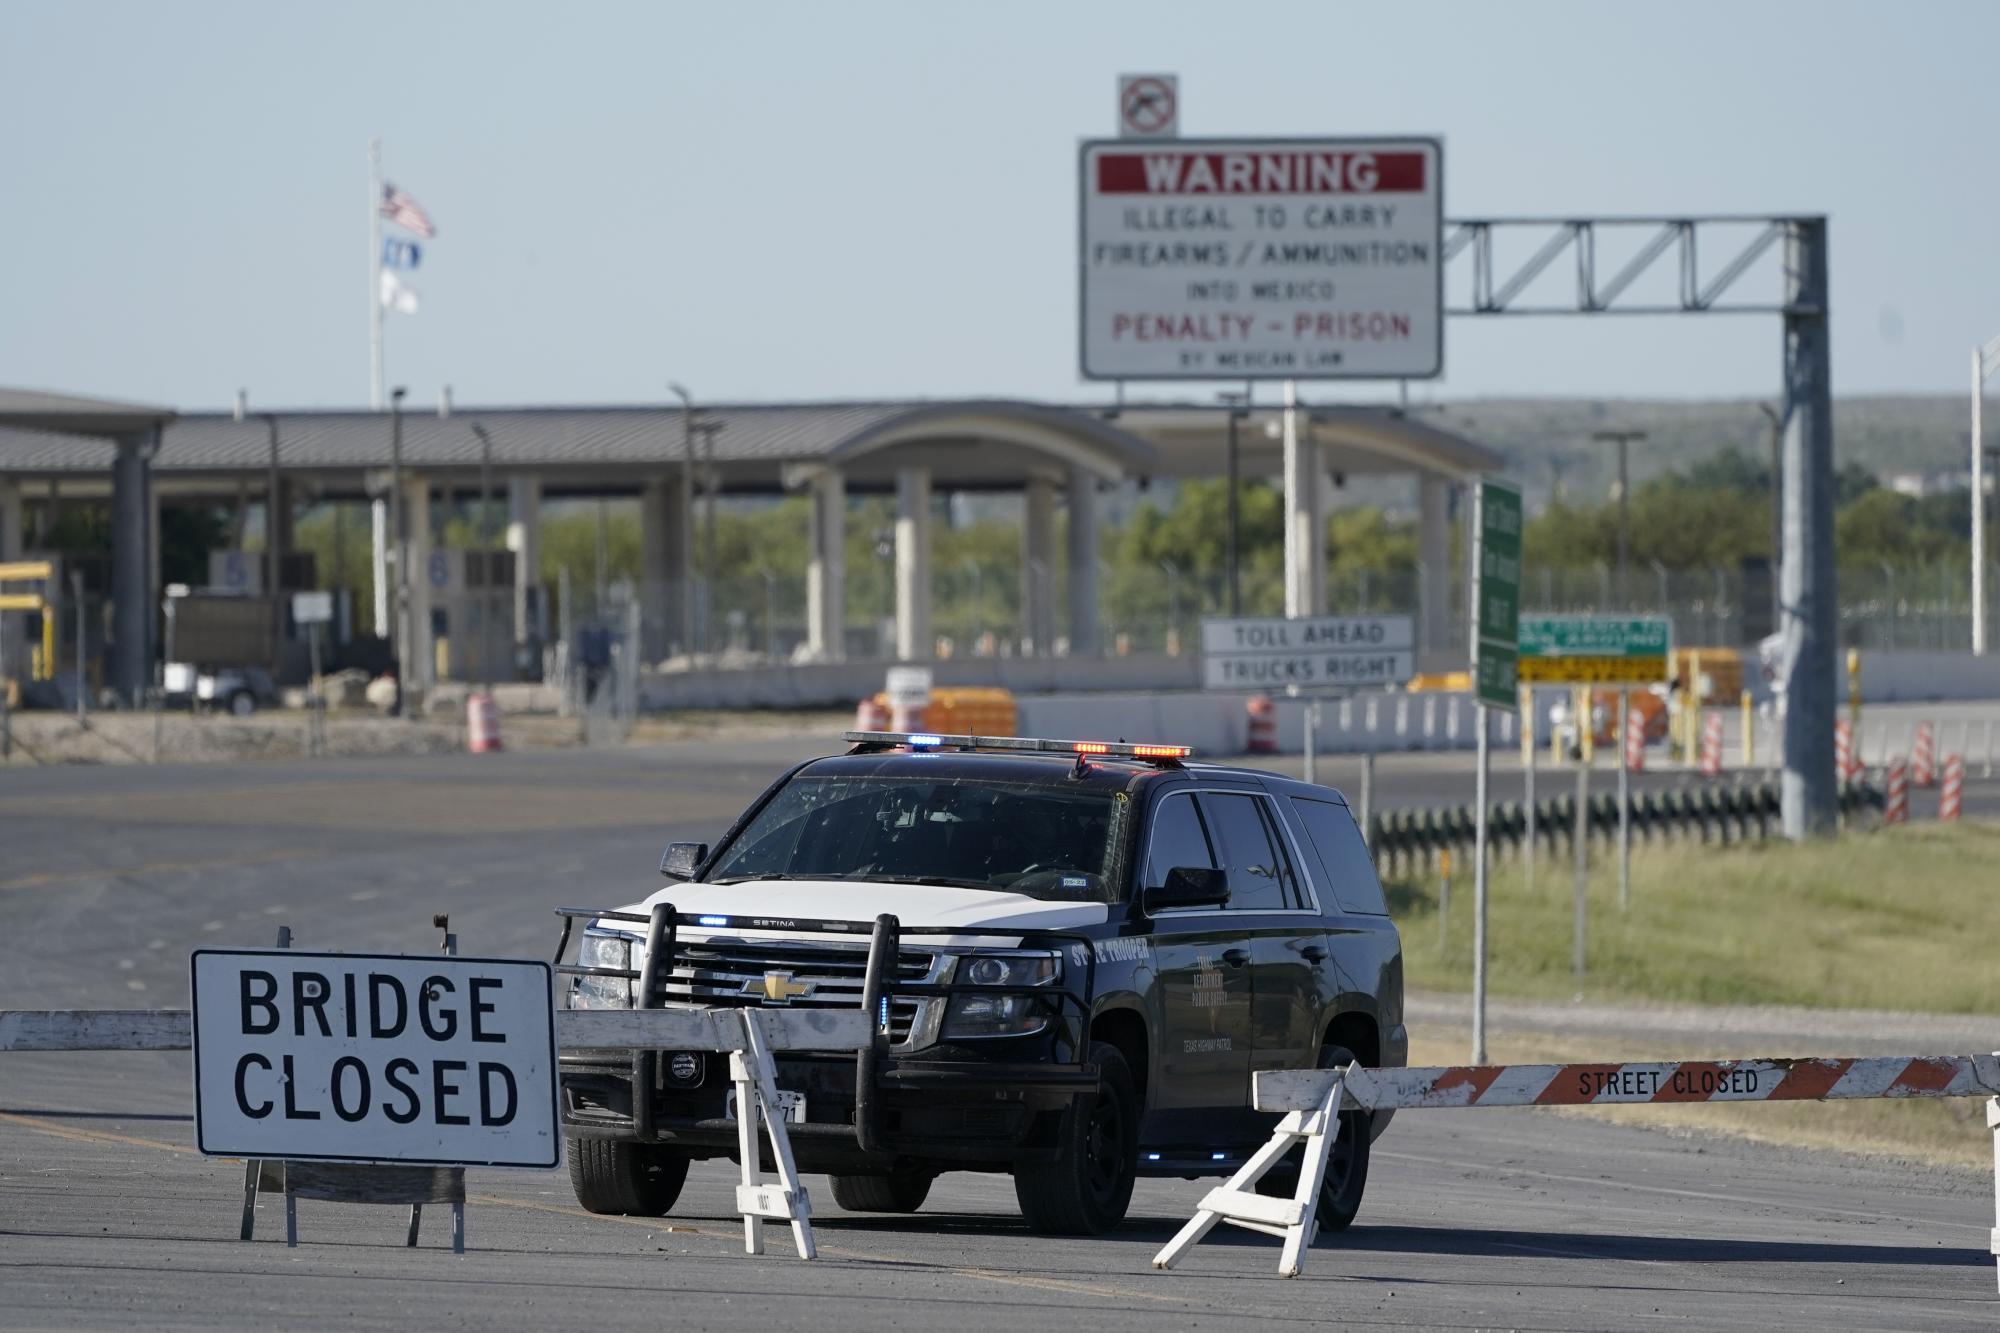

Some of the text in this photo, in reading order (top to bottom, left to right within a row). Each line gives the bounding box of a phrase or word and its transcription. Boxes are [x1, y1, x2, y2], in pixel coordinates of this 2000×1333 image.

[1143, 154, 1380, 193] WARNING
[1123, 205, 1397, 230] ILLEGAL TO CARRY
[1187, 280, 1336, 301] INTO MEXICO
[1112, 314, 1255, 341] PENALTY
[1293, 312, 1410, 339] PRISON
[1180, 350, 1344, 366] BY MEXICAN LAW
[1234, 623, 1386, 647] TOLL AHEAD
[1222, 655, 1397, 680] TRUCKS RIGHT
[753, 919, 796, 928] SETINA
[1072, 937, 1150, 967] STTE TROOPER
[1193, 973, 1224, 989] DEPARTMENT
[239, 969, 507, 1044] BRIDGE
[1192, 991, 1210, 1007] PUBLIC
[1184, 1038, 1232, 1053] TEXAS HIGHWAY PATROL
[234, 1052, 519, 1127] CLOSED
[1579, 1069, 1758, 1096] STREET CLOSED
